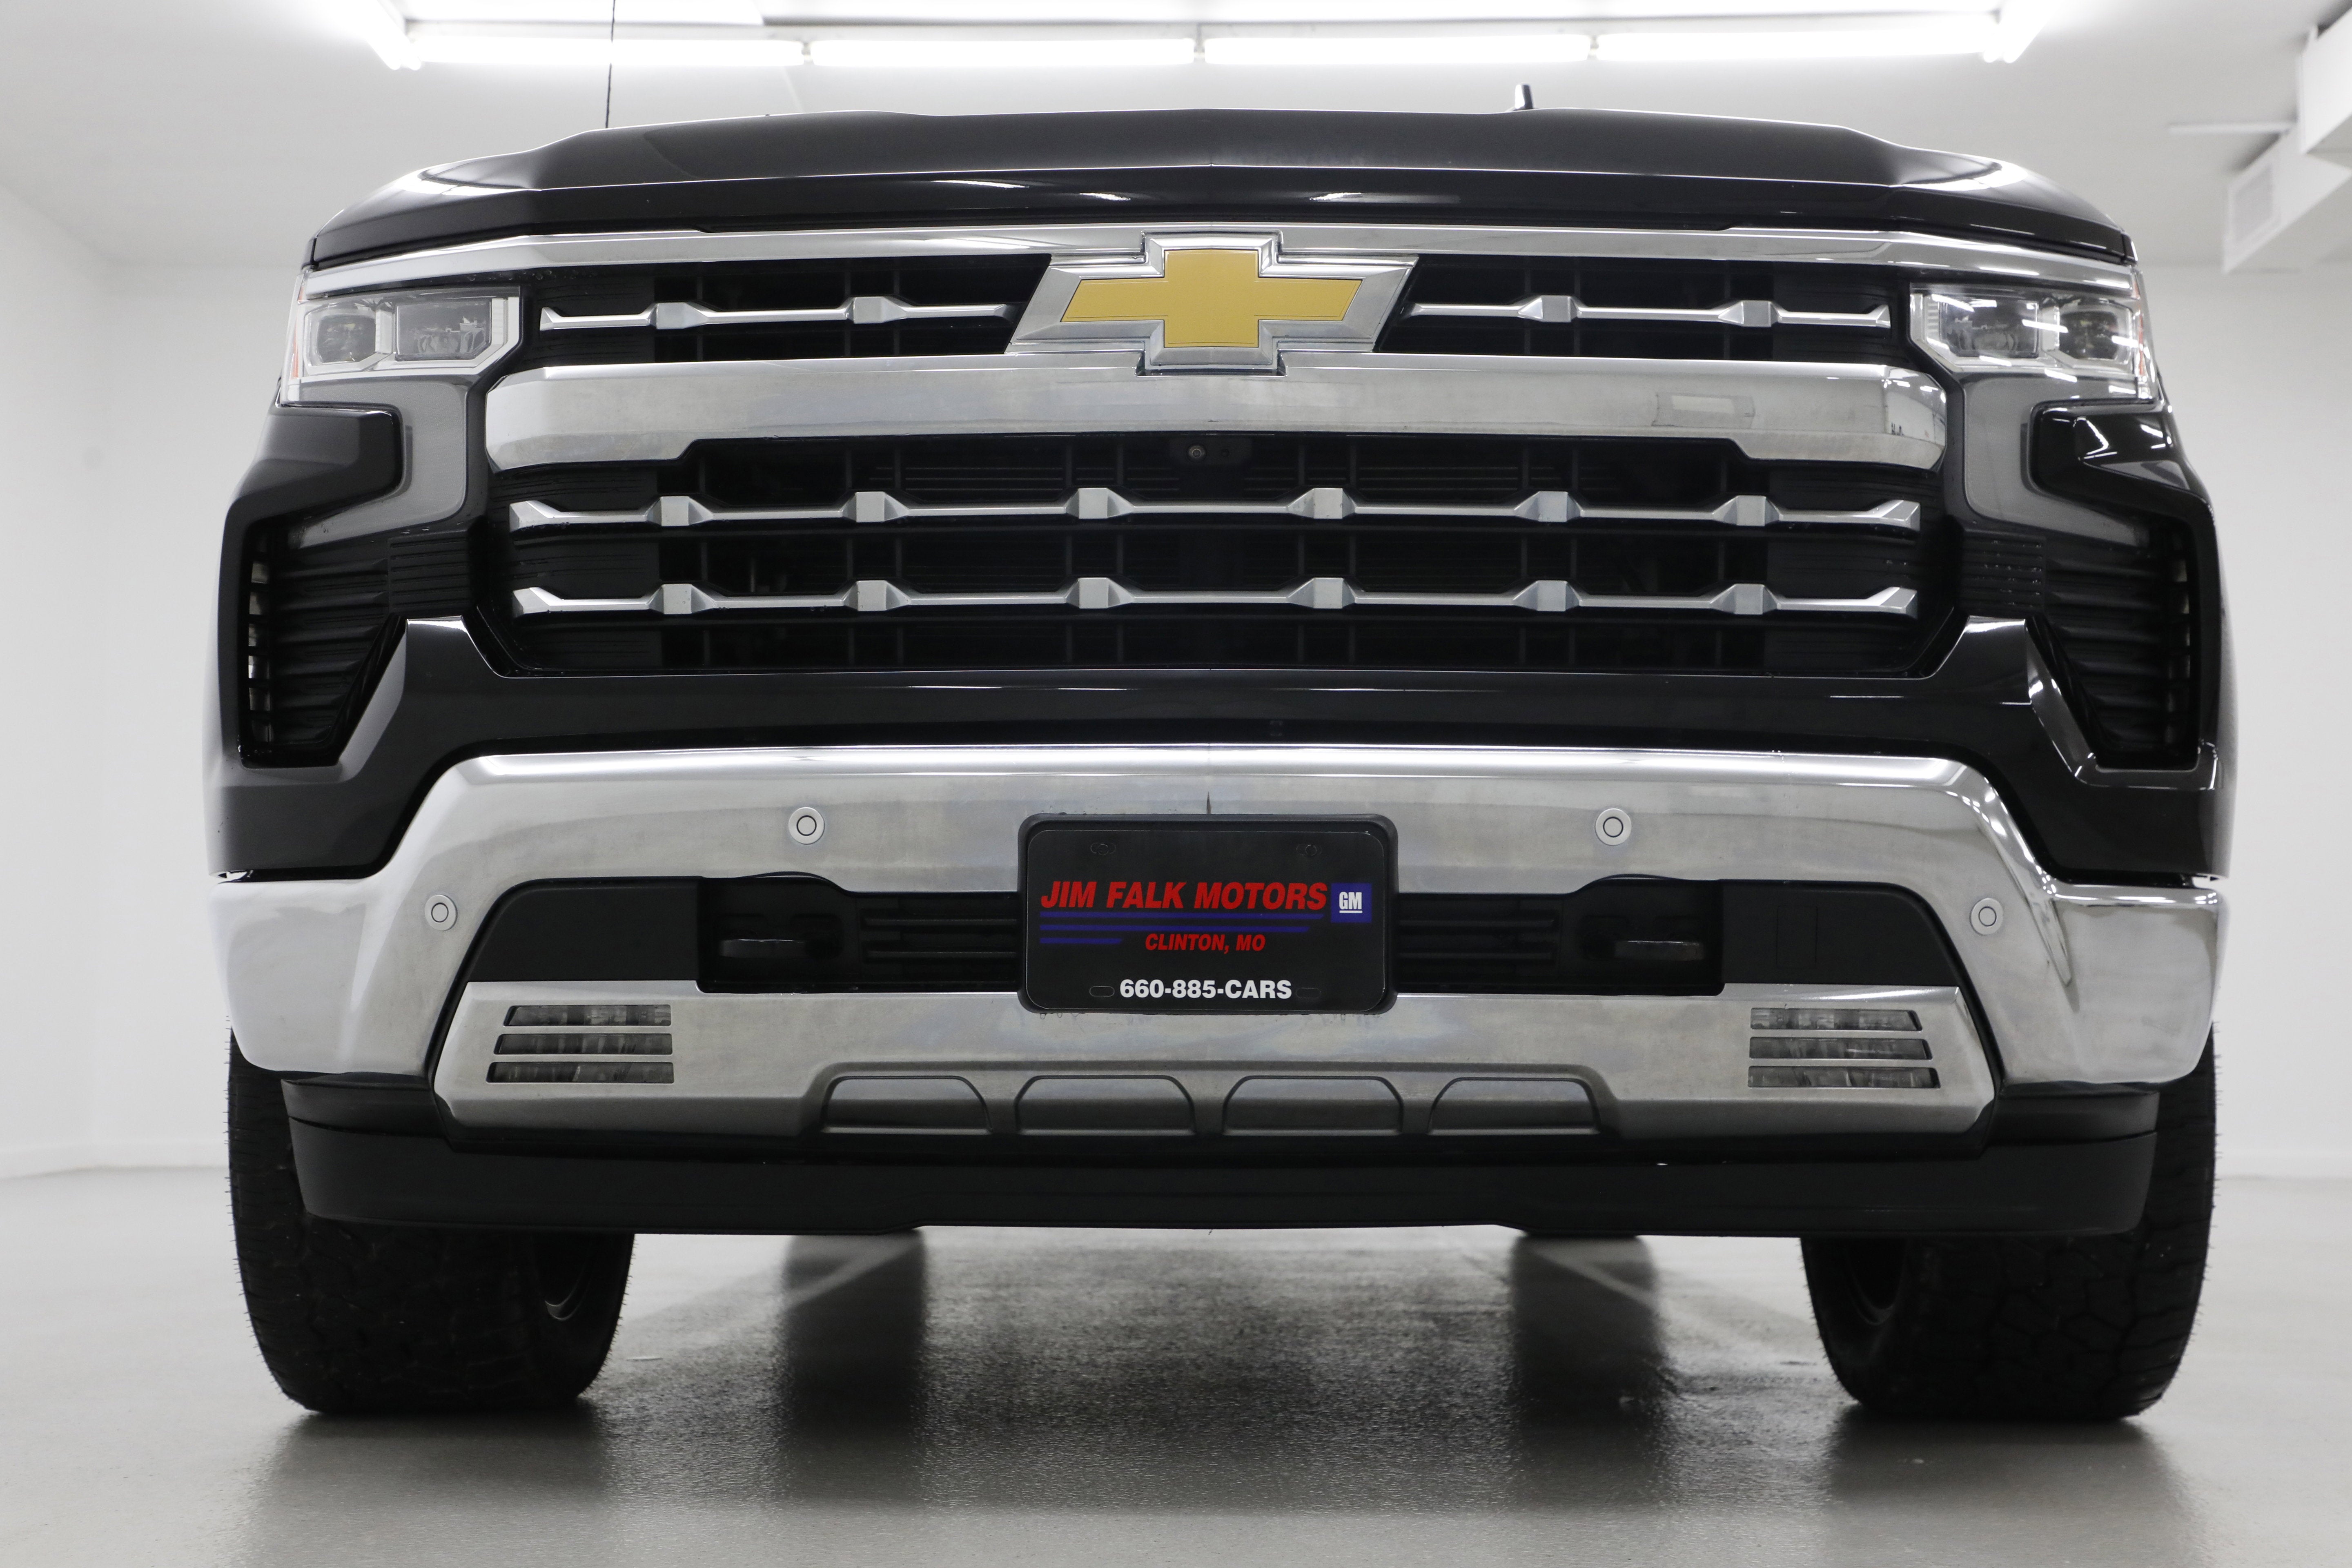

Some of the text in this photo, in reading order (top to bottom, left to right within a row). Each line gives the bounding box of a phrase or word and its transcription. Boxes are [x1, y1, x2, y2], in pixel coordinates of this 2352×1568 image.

[1040, 881, 1328, 911] JIM FALK MOTORS
[1339, 891, 1363, 910] GM
[1145, 933, 1266, 955] CLINTON, MO
[1120, 979, 1292, 999] 660-885-CARS
